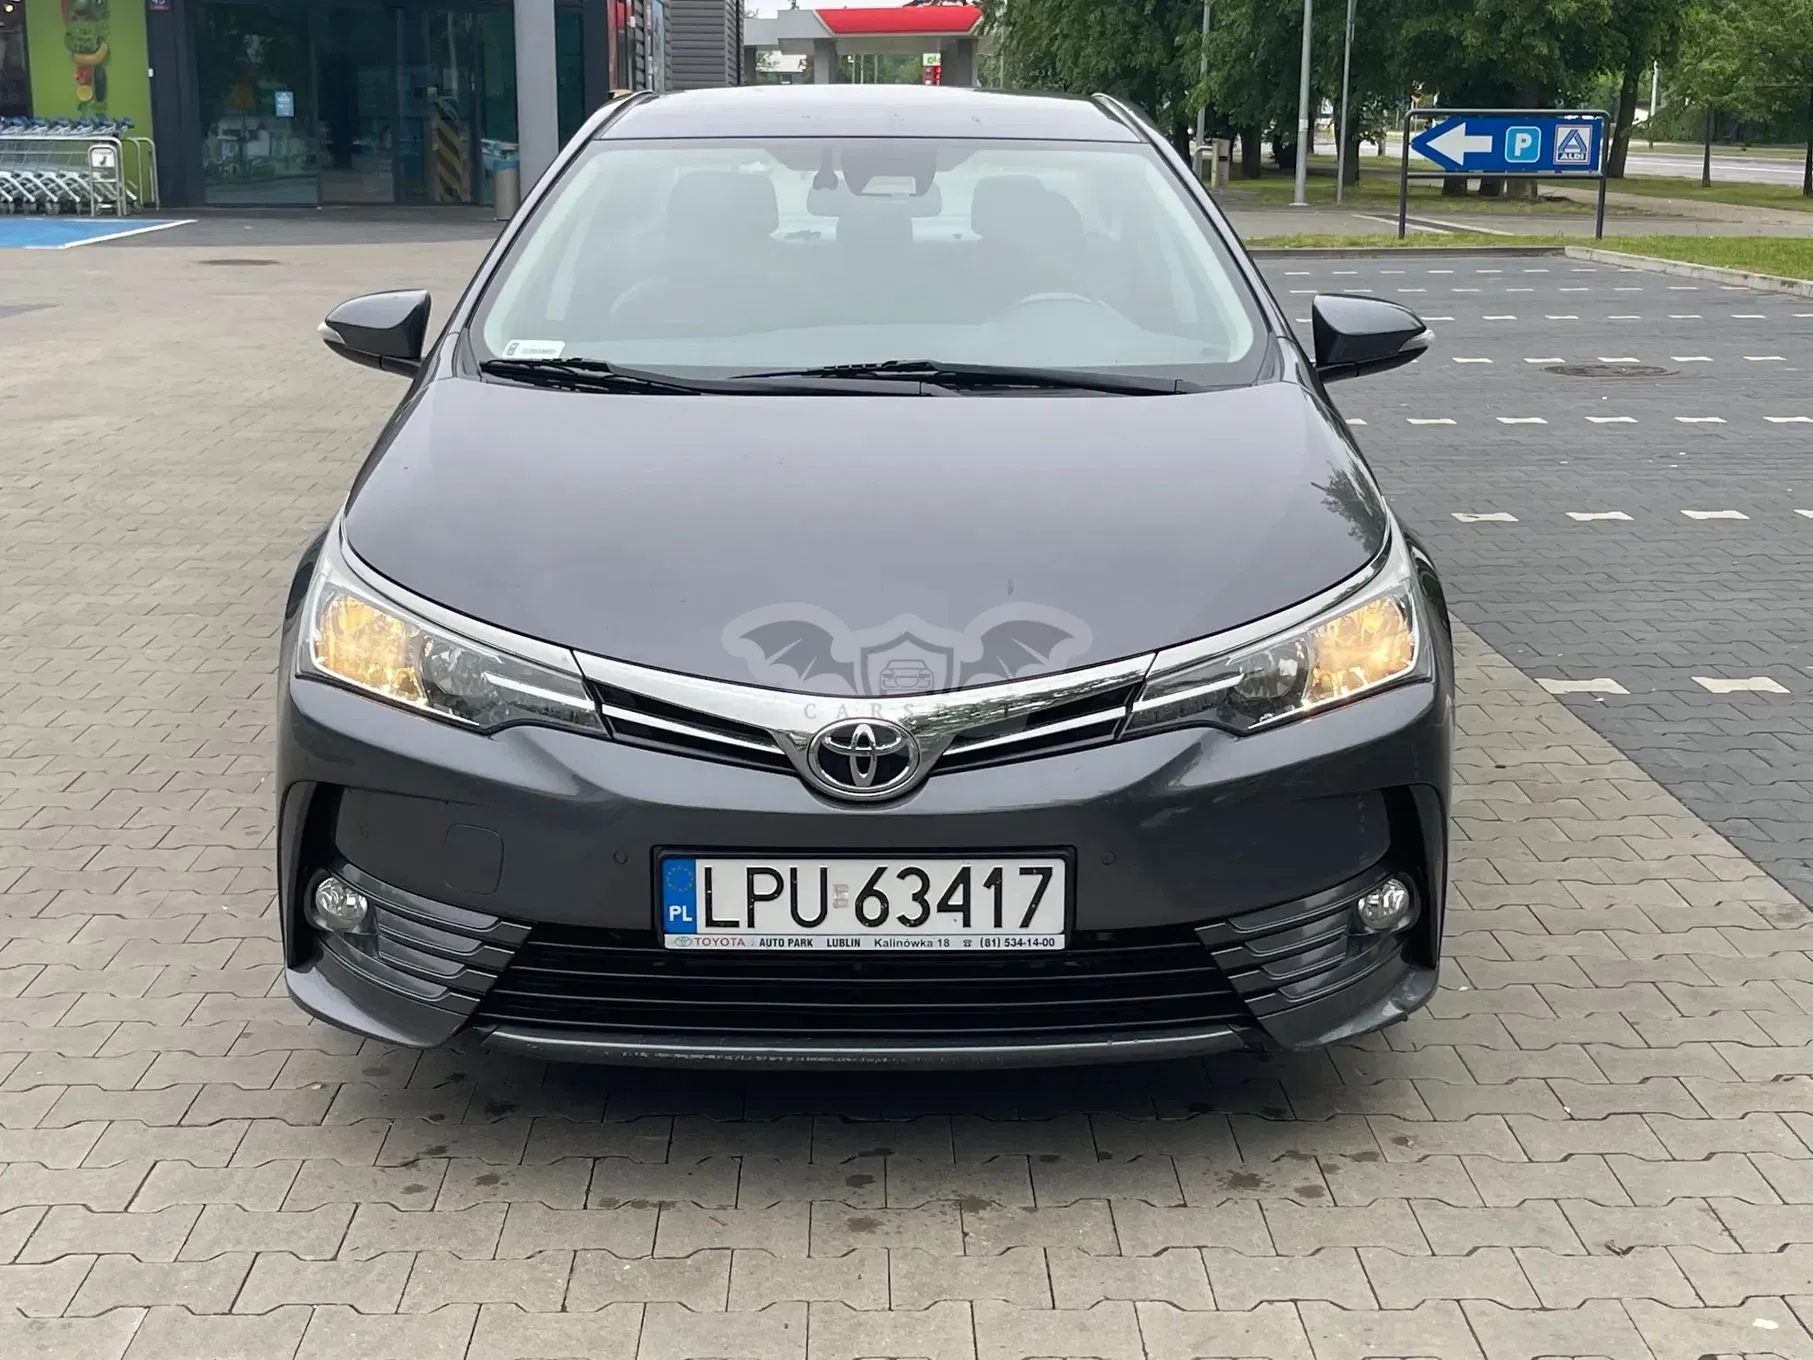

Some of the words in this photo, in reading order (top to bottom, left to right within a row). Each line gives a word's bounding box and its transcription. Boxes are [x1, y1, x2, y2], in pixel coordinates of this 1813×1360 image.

[1514, 133, 1532, 156] P
[704, 866, 829, 929] LPU
[854, 866, 1054, 929] 63417
[669, 905, 693, 922] PL
[694, 937, 746, 947] TOYOTA
[759, 938, 785, 948] AUTO
[788, 938, 814, 948] PARK
[826, 938, 861, 948] LUBLIN
[874, 937, 933, 948] Kalinówka
[937, 938, 950, 948] 18
[980, 937, 1001, 948] (81)
[1004, 937, 1055, 948] 534-14-00
